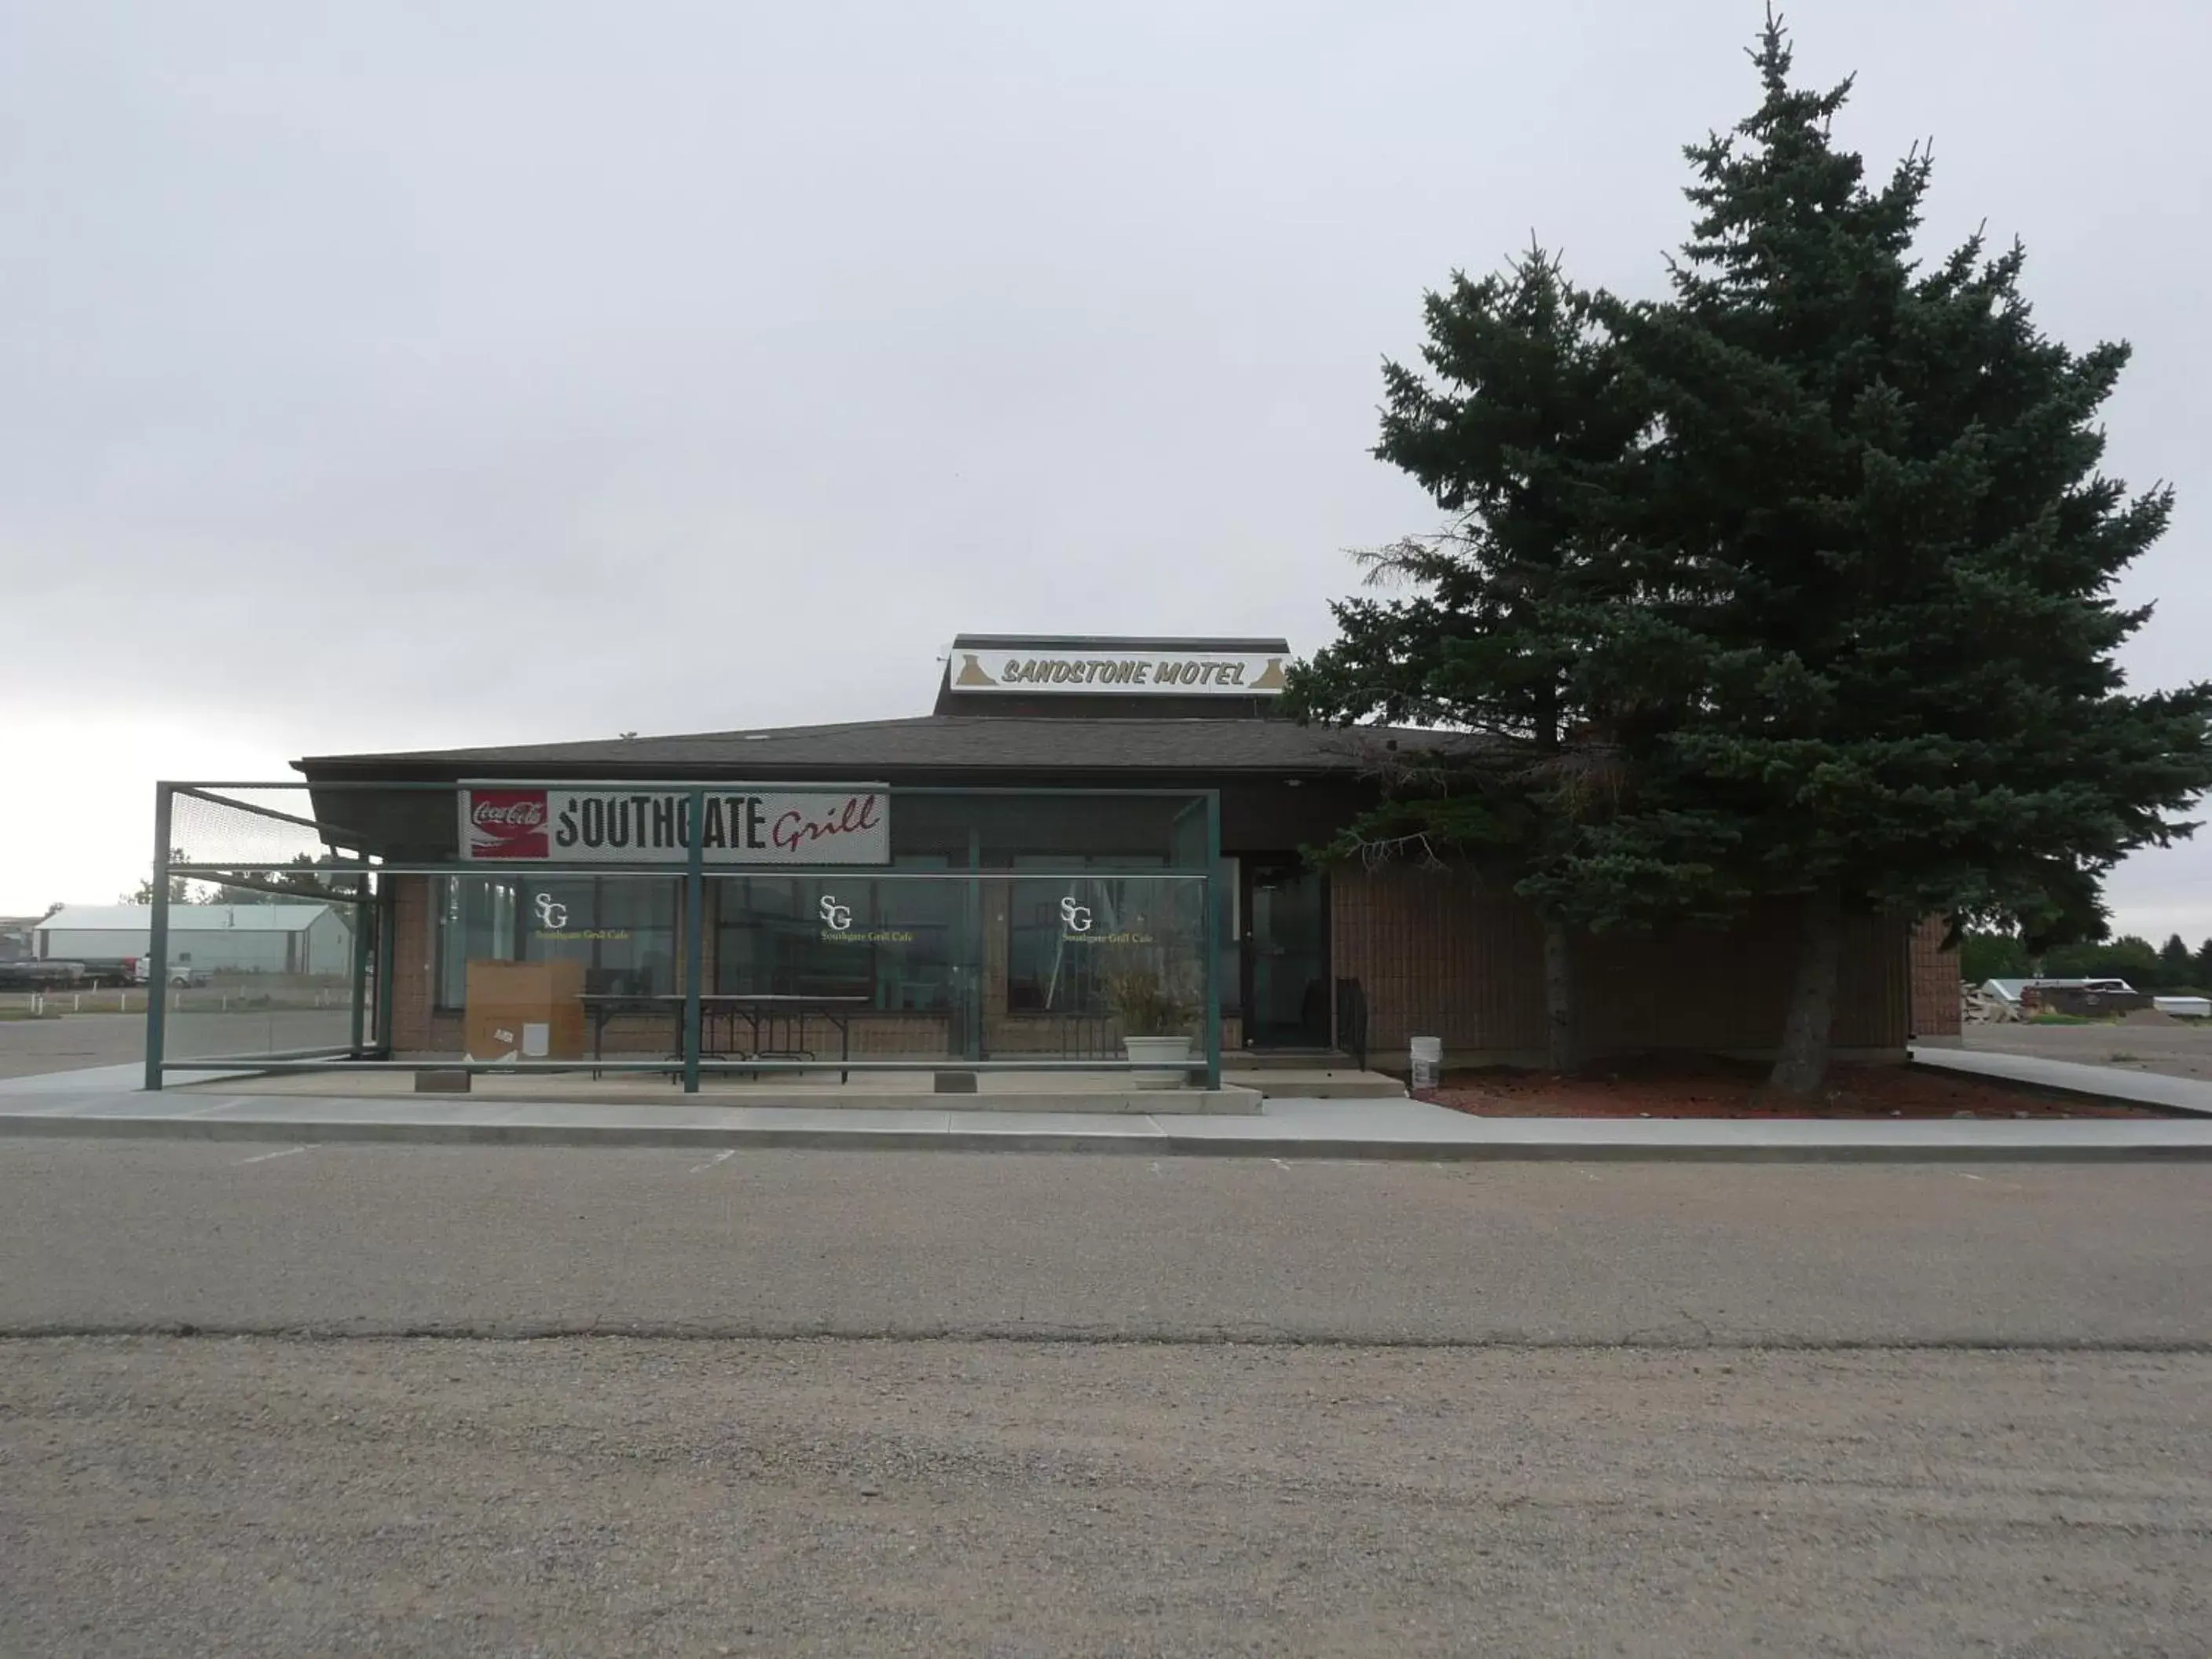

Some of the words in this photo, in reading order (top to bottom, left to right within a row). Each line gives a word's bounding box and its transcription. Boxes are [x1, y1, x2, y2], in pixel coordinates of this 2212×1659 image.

[1001, 658, 1152, 684] SANDSTONE
[1153, 661, 1248, 686] MOTEL
[555, 796, 767, 848] SOUTHGATE
[773, 795, 880, 852] Grill
